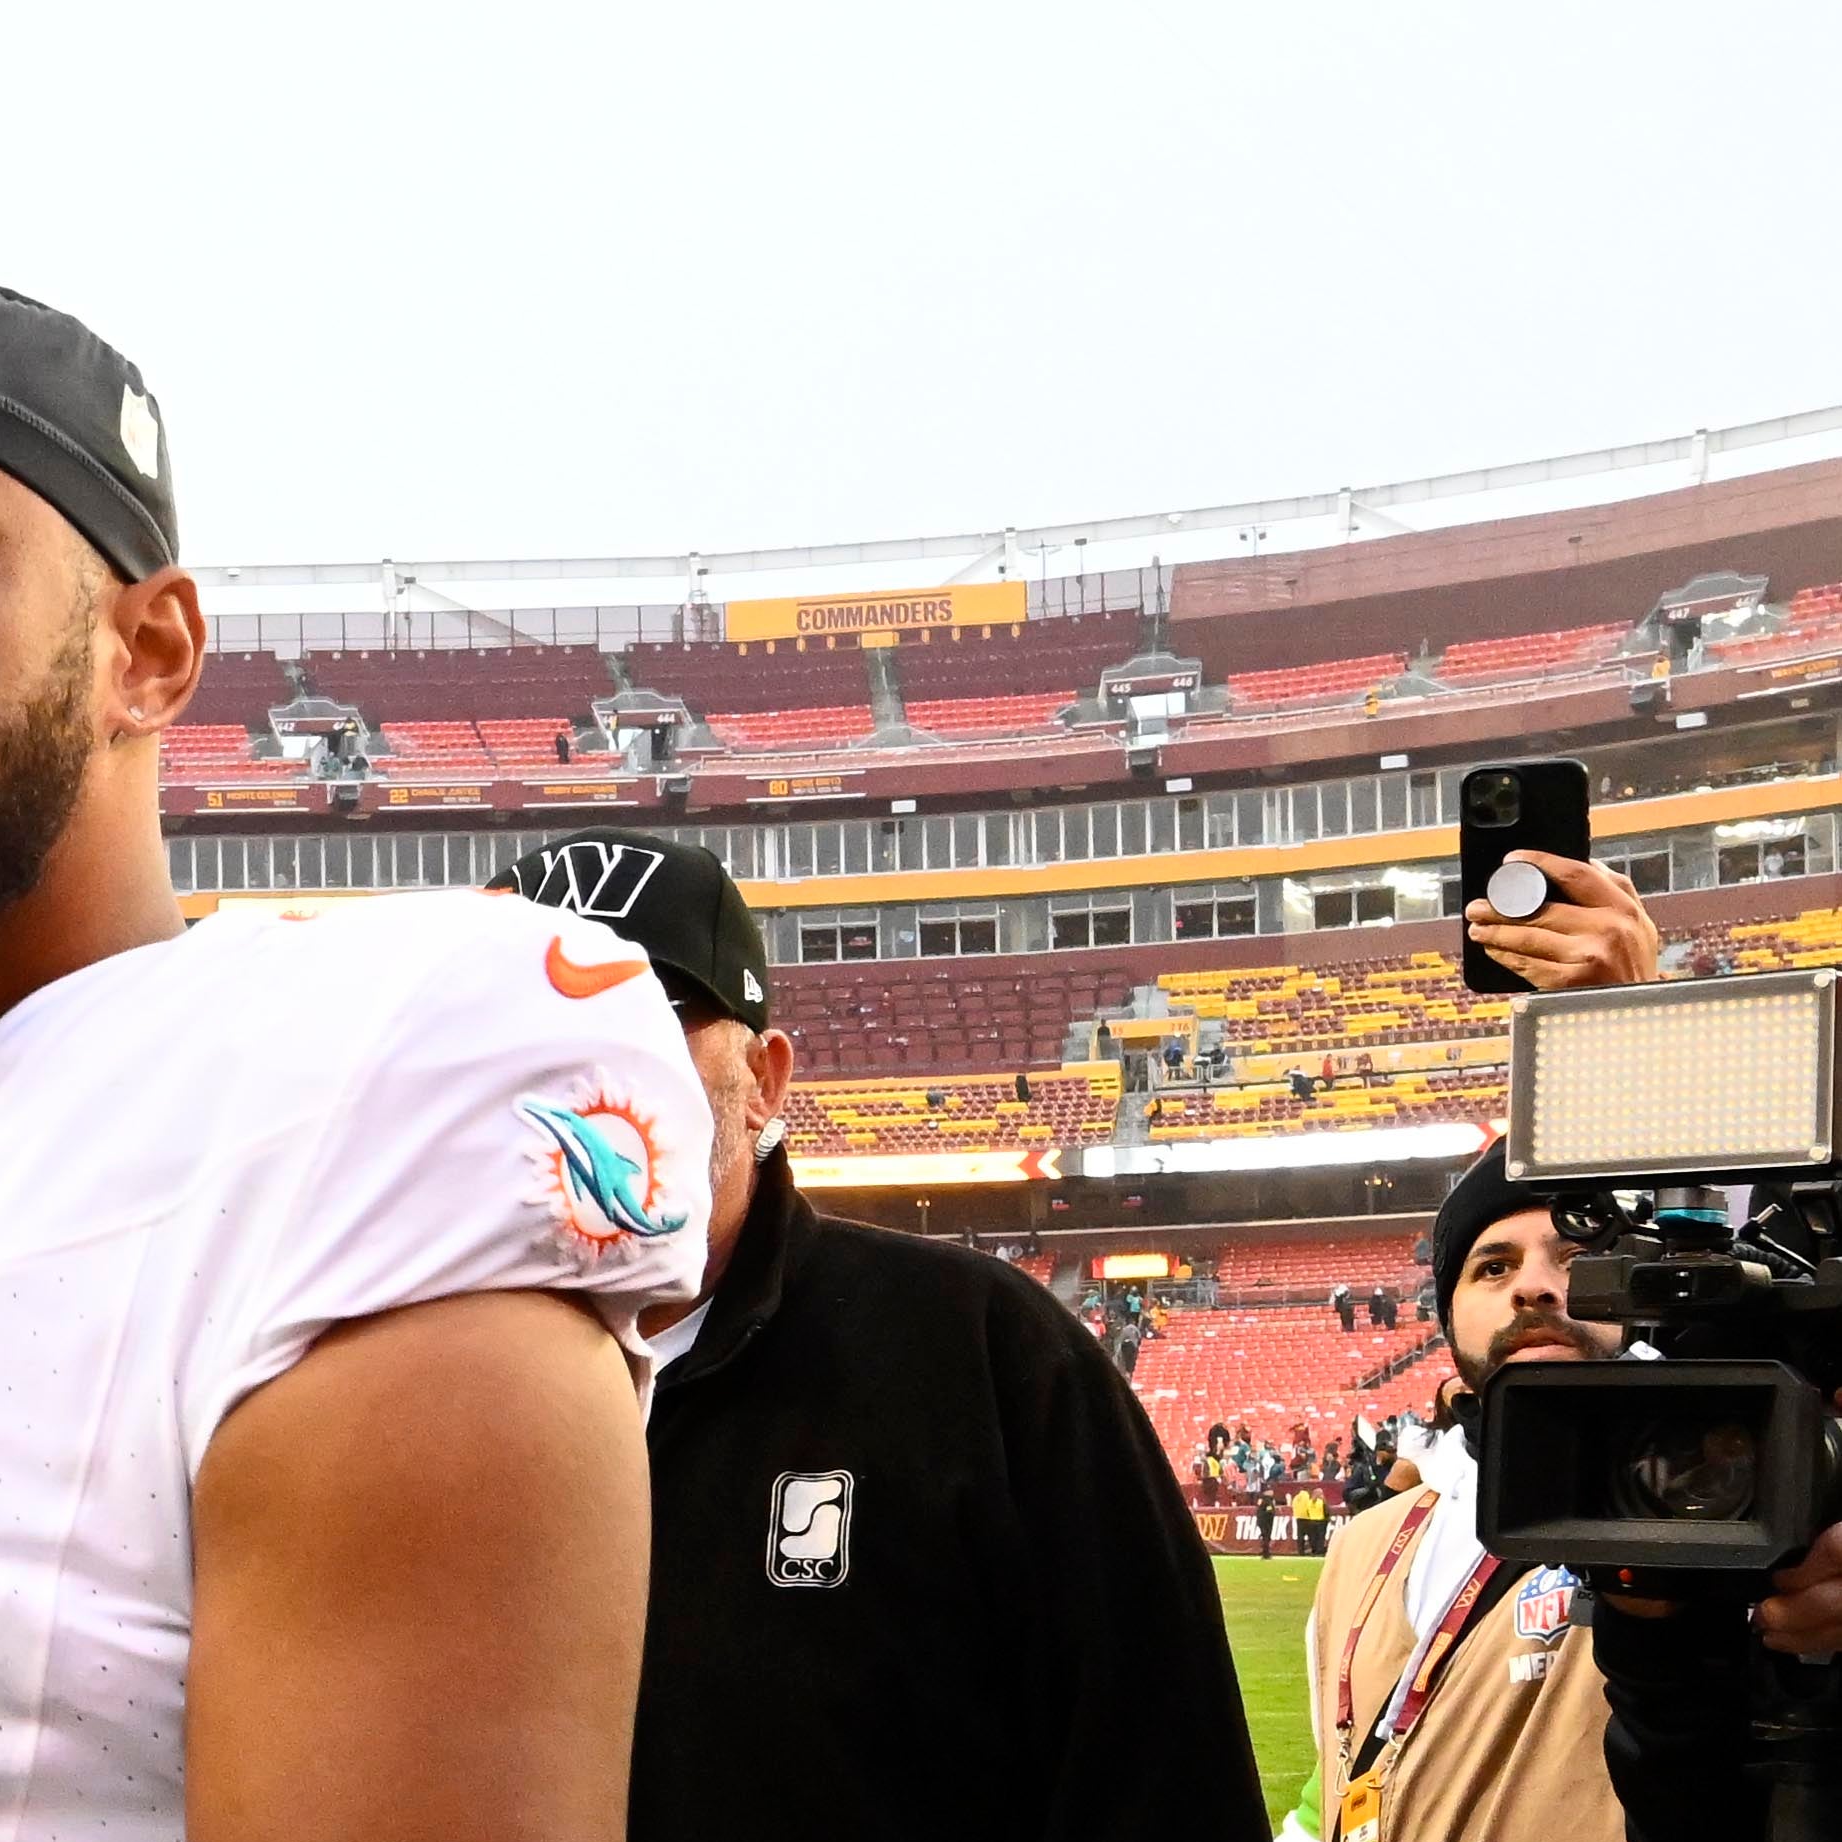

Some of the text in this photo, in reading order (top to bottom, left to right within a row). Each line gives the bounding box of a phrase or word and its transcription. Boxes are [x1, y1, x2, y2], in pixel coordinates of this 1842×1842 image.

[796, 598, 953, 632] COMMANDERS
[207, 791, 224, 808] 51
[389, 788, 408, 804] 22
[781, 1558, 835, 1580] CSC
[1522, 1590, 1569, 1630] NFL
